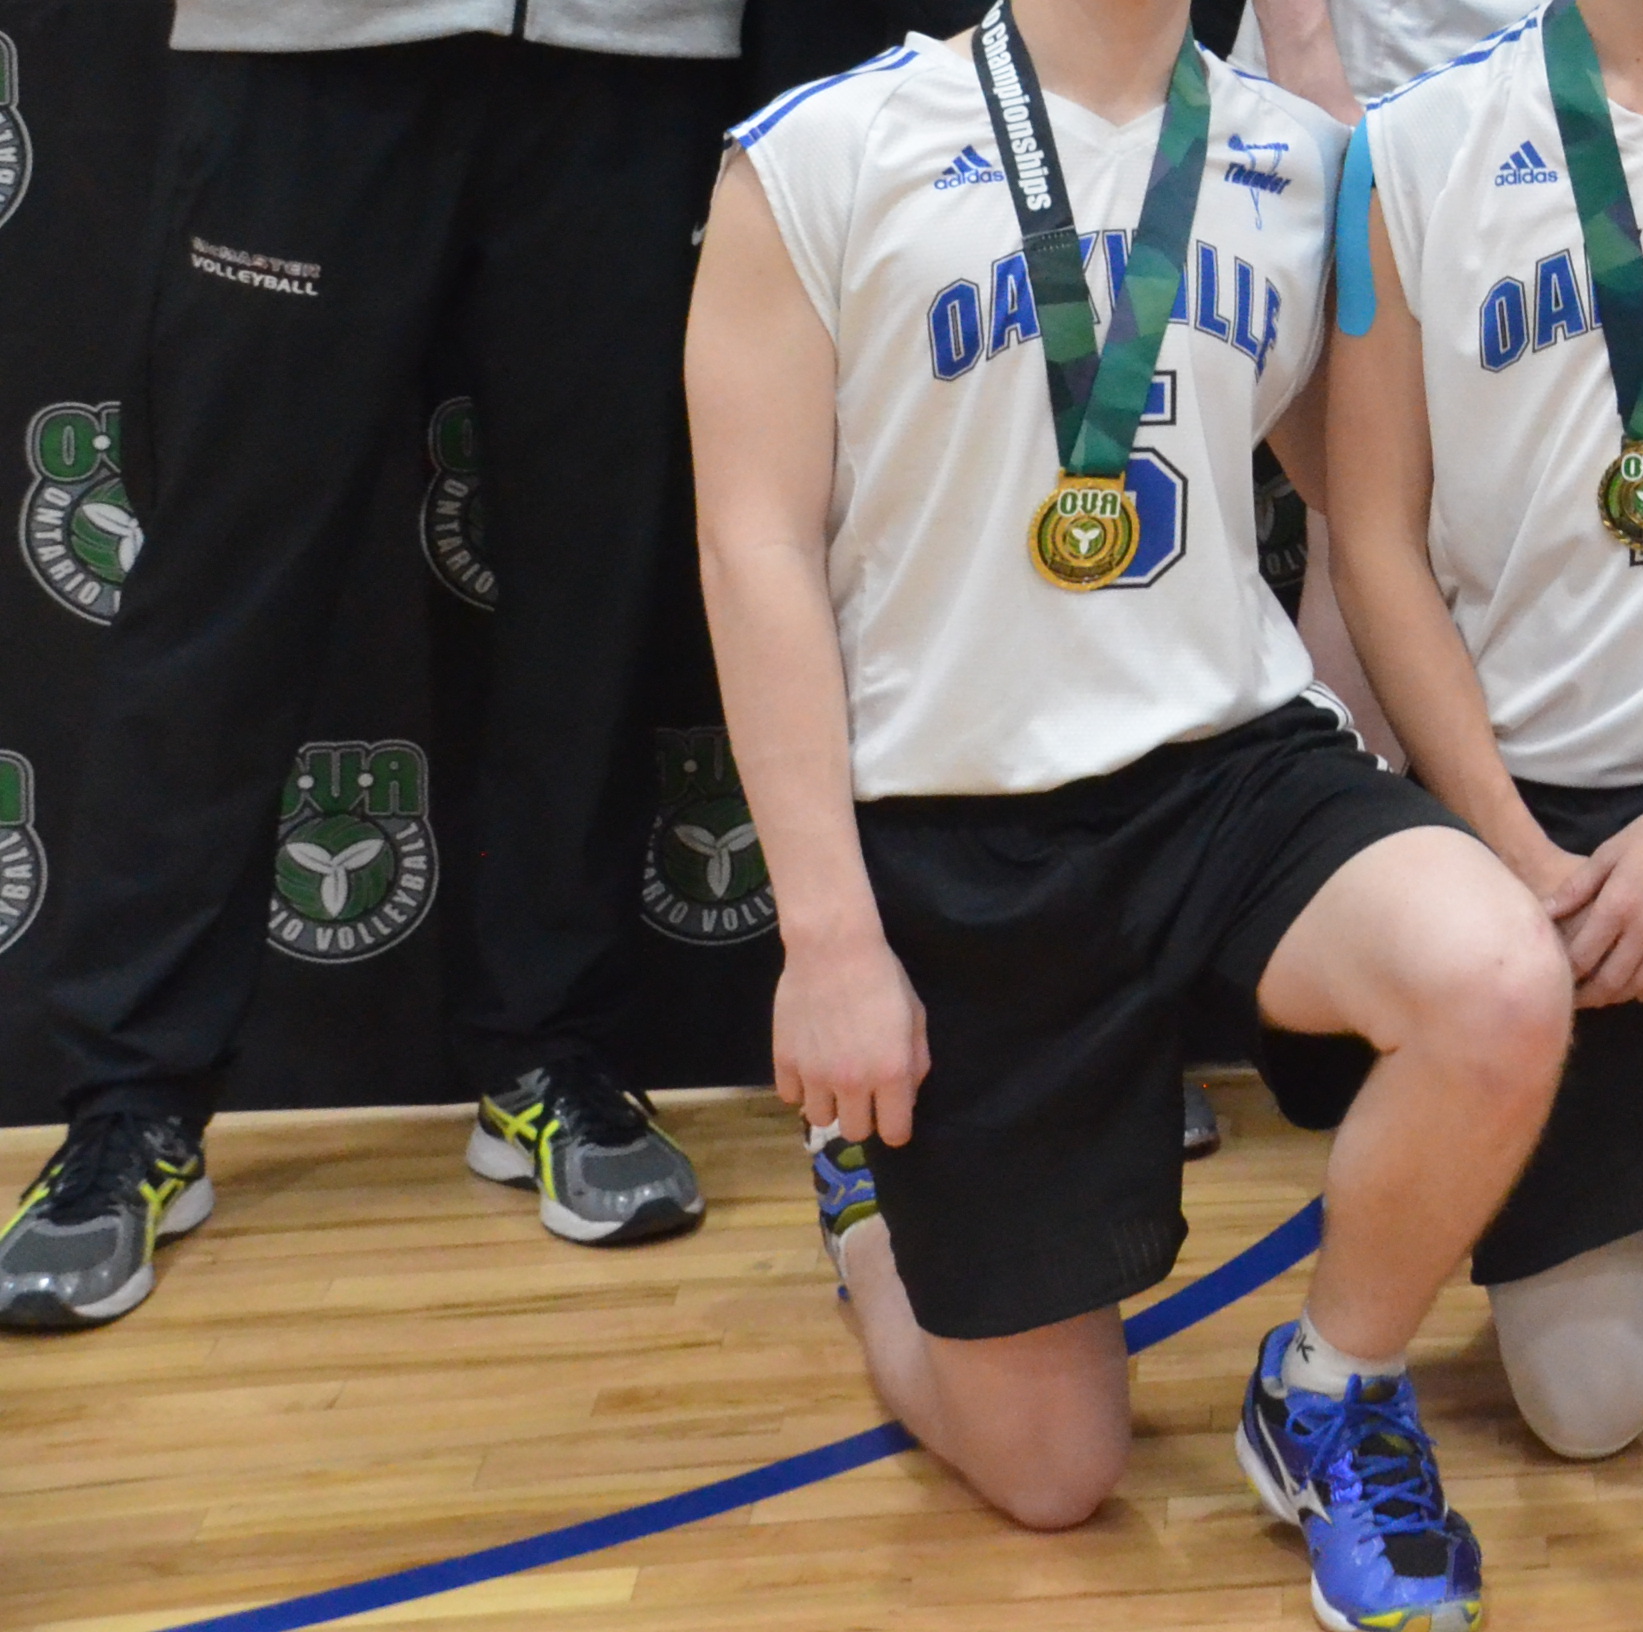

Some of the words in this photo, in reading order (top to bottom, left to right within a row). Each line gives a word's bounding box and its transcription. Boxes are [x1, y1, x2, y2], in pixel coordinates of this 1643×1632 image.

[982, 19, 1052, 211] Championships
[934, 169, 1004, 191] adidas
[1494, 164, 1558, 186] adidas
[190, 253, 319, 297] VOLLEYBALL
[1057, 489, 1119, 518] OVA
[35, 485, 103, 604] ONTARIO
